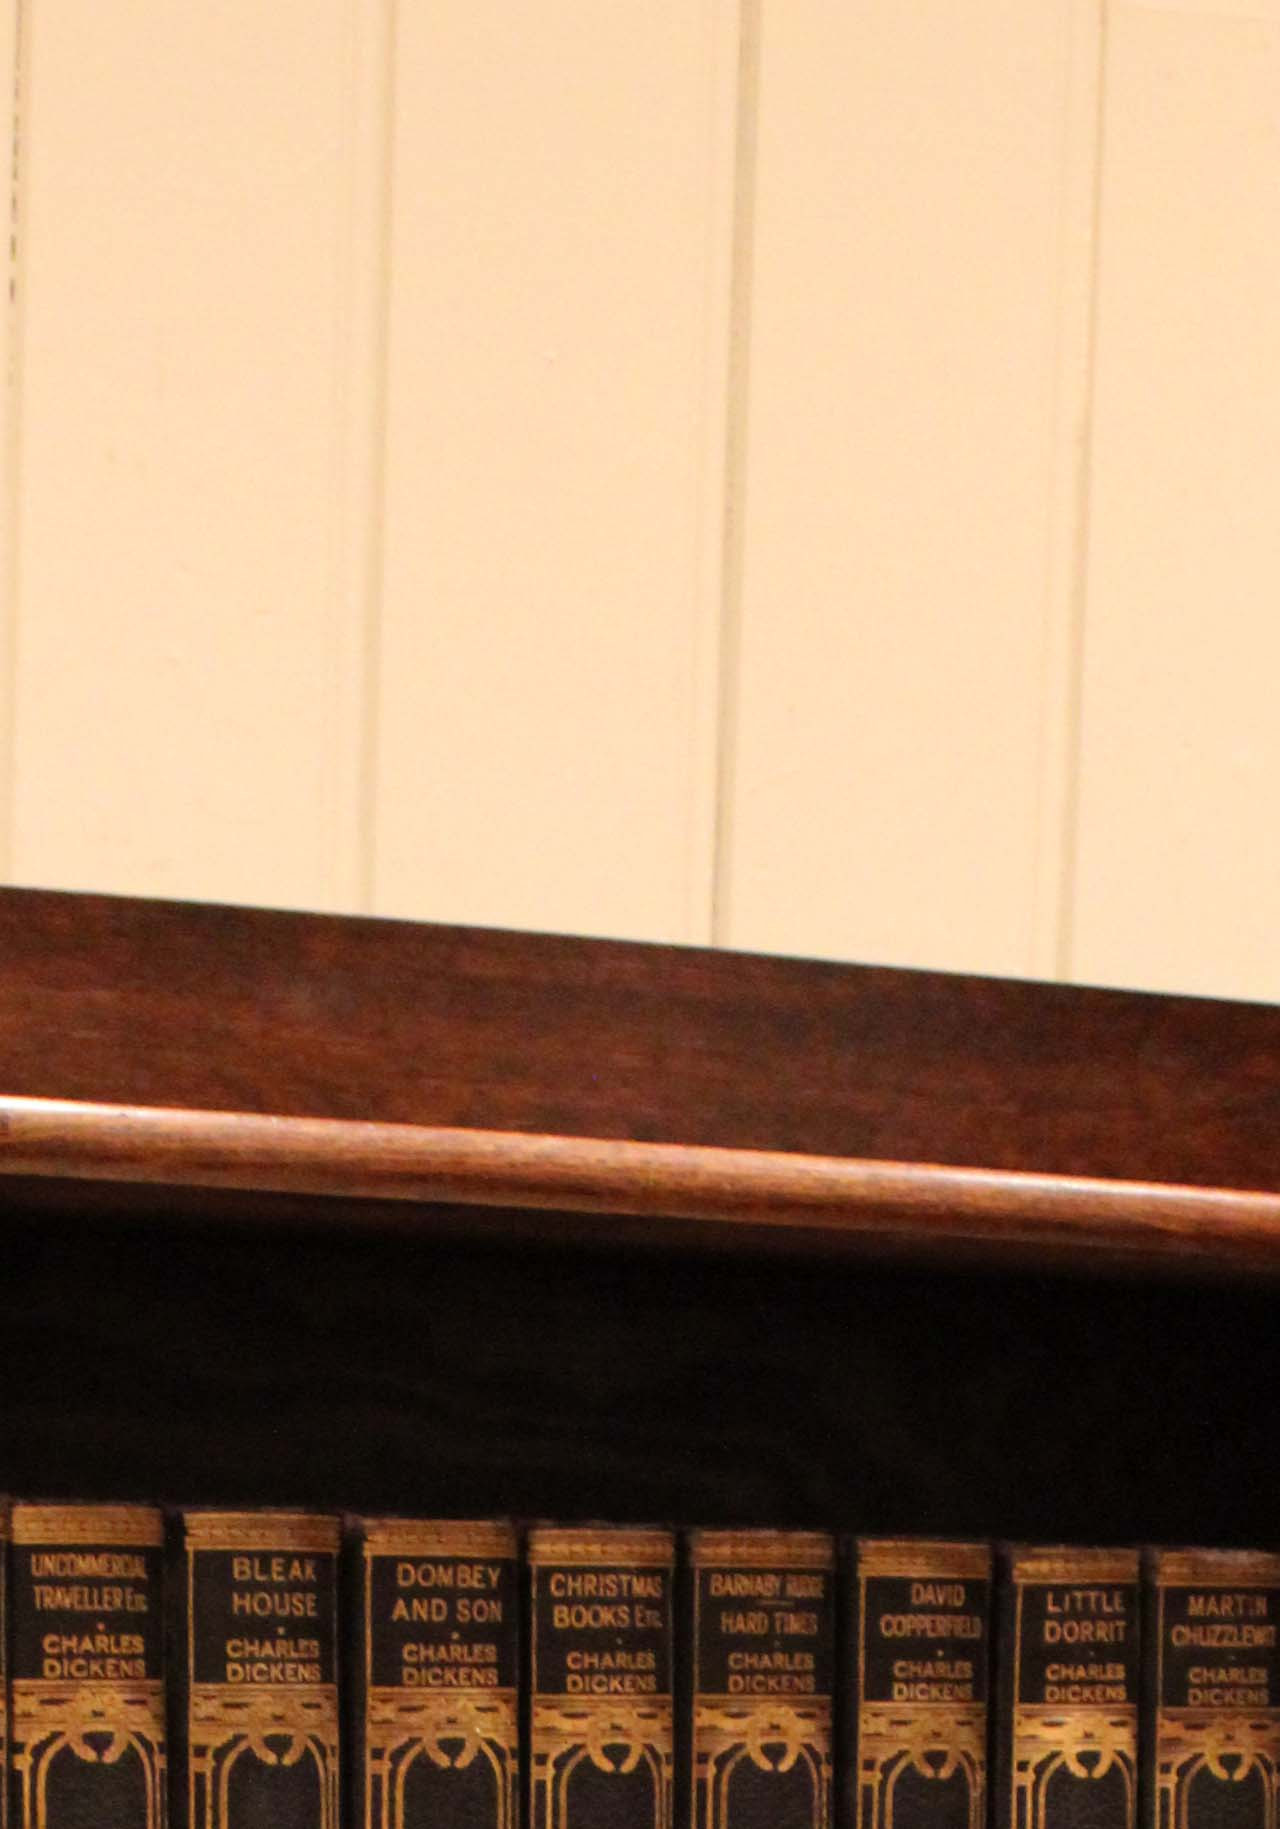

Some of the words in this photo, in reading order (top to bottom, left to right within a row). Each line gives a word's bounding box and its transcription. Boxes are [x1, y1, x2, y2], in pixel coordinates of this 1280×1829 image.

[232, 1557, 317, 1583] BLEAK
[396, 1562, 502, 1590] DOMBEY
[549, 1573, 663, 1601] CHRISTMAS
[910, 1581, 967, 1608] DAVID
[232, 1593, 318, 1618] HOUSE
[392, 1598, 448, 1624] AND
[455, 1596, 504, 1624] SON
[553, 1604, 632, 1629] BOOKS
[1044, 1619, 1128, 1645] DORRIT
[42, 1633, 145, 1655] CHARLES
[226, 1637, 320, 1660] CHARLES
[402, 1642, 498, 1664] CHARLES
[43, 1657, 146, 1679] DICKENS
[566, 1651, 657, 1671] CHARLES
[727, 1651, 816, 1671] CHARLES
[226, 1661, 321, 1684] DICKENS
[402, 1666, 499, 1688] DICKENS
[566, 1673, 658, 1694] DICKENS
[727, 1673, 816, 1693] DICKENS
[1046, 1663, 1127, 1683] CHARLES
[1045, 1684, 1128, 1704] DICKENS
